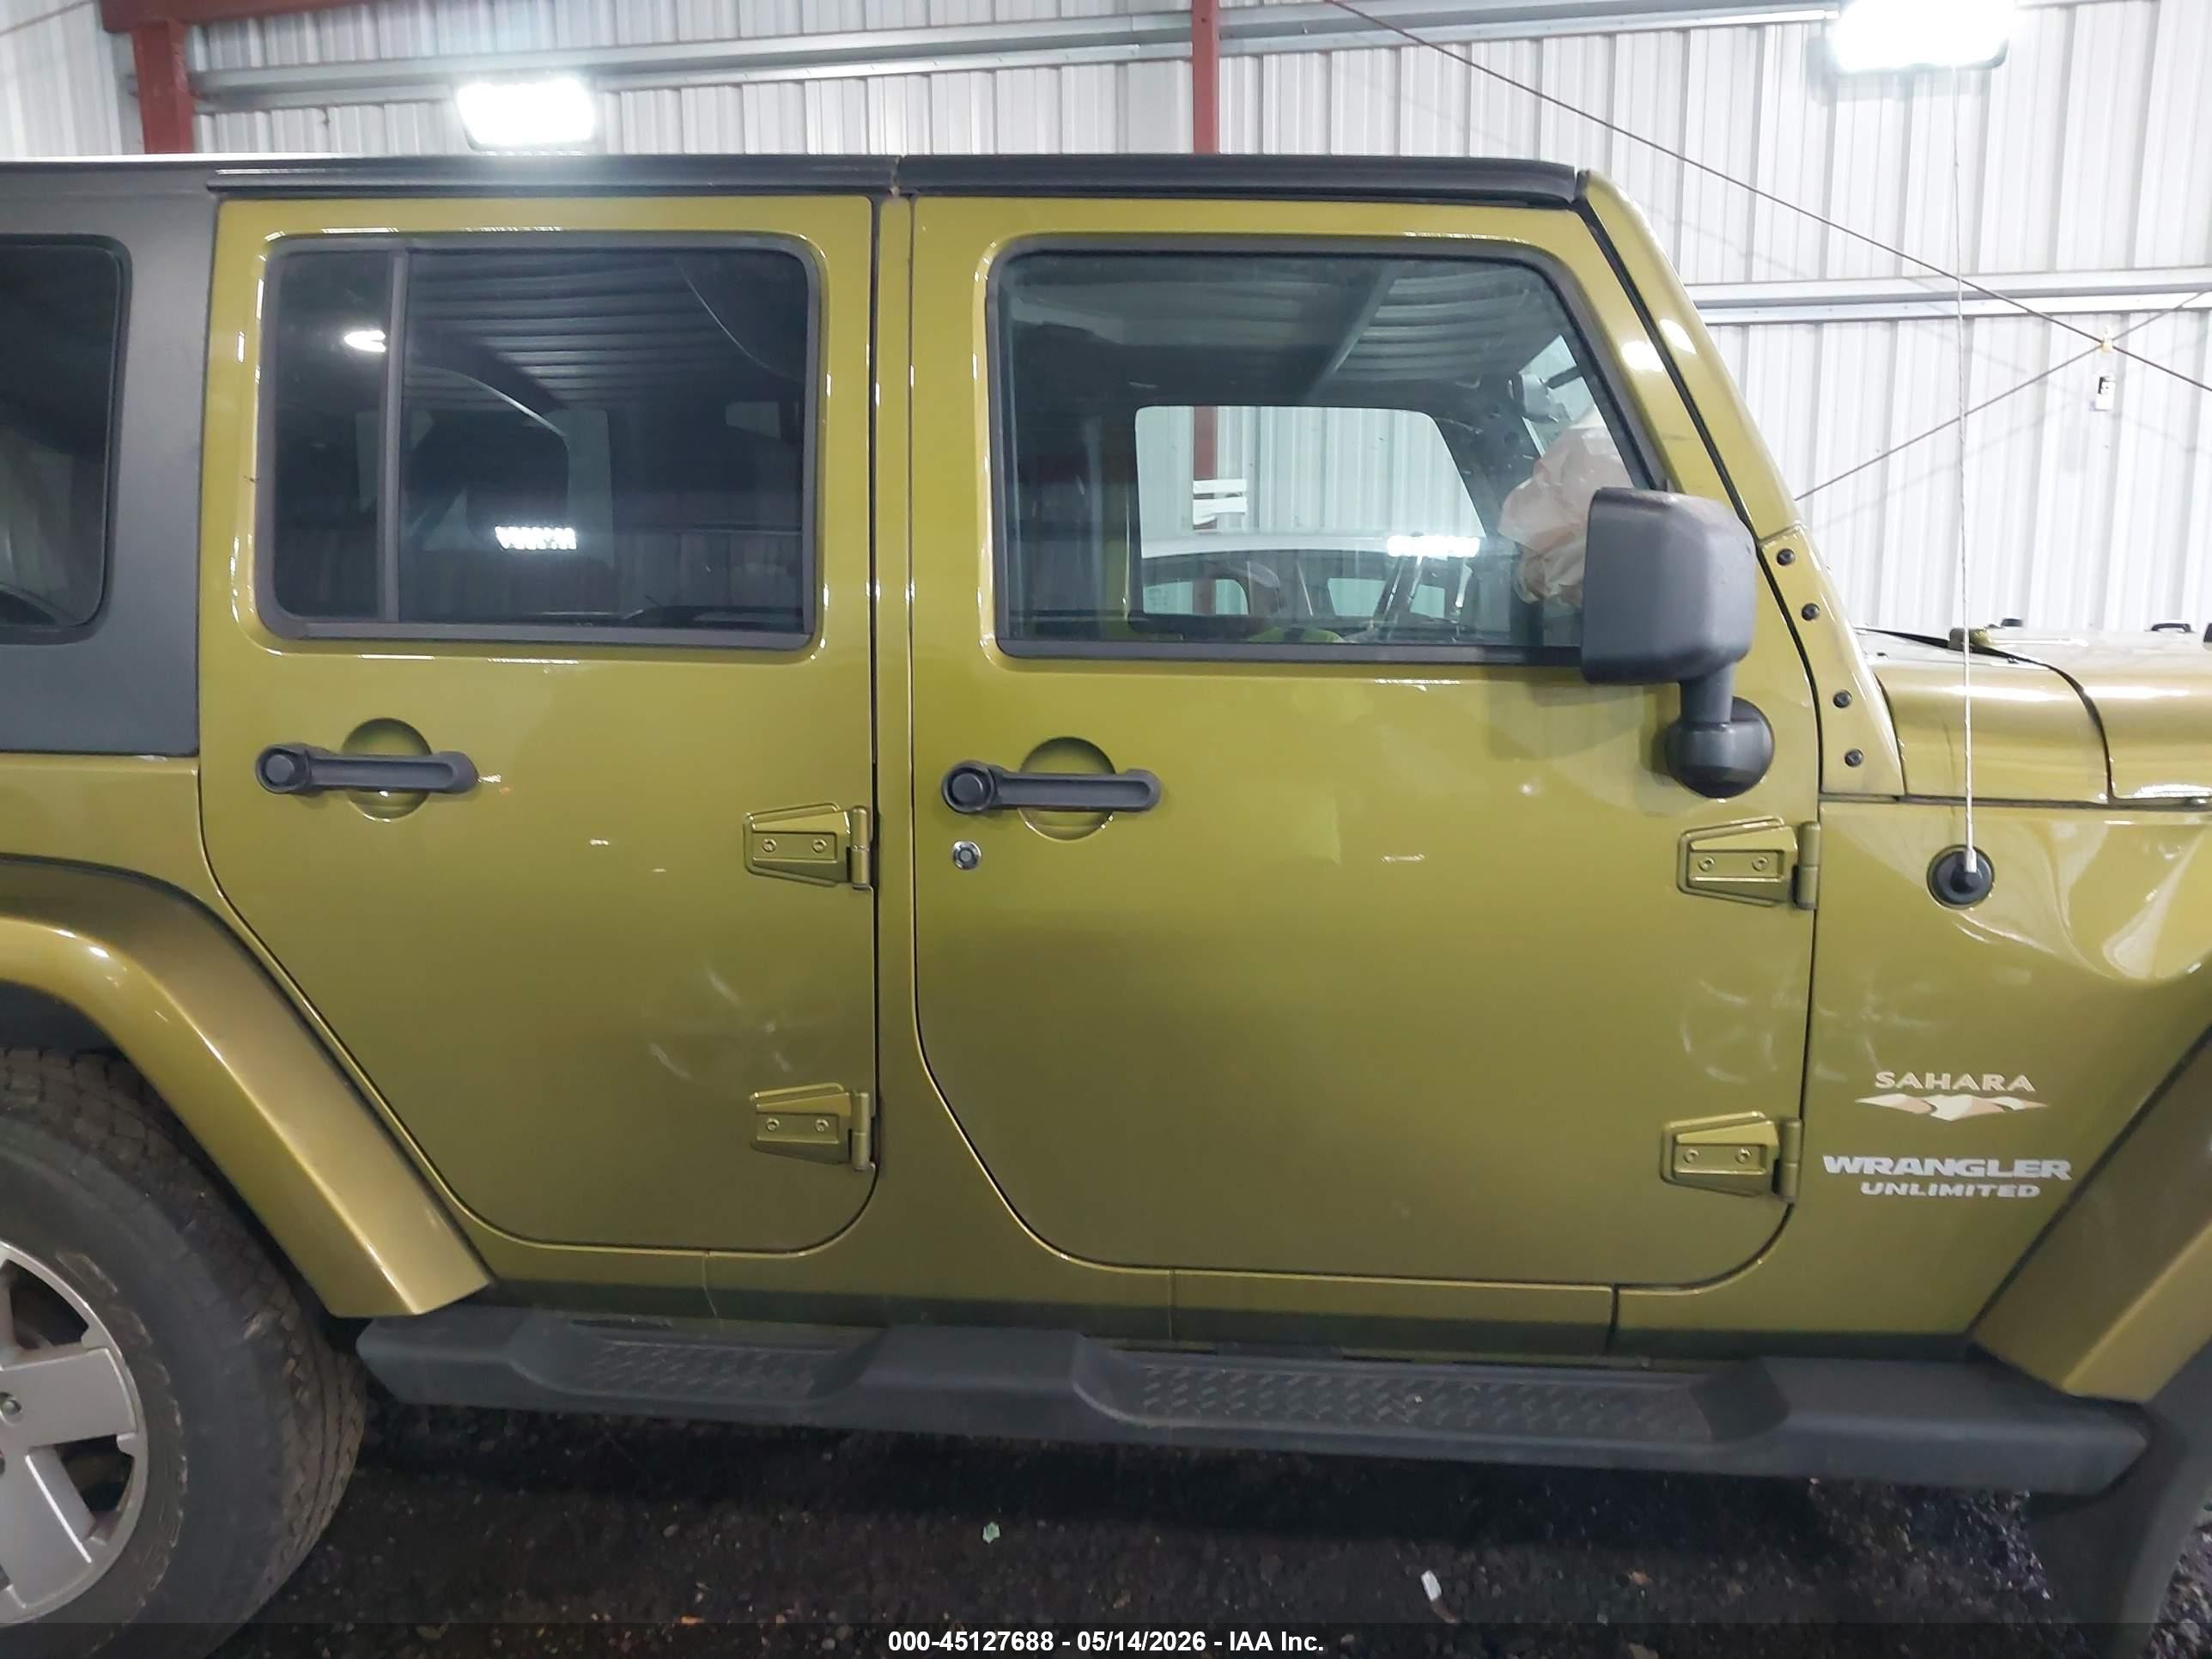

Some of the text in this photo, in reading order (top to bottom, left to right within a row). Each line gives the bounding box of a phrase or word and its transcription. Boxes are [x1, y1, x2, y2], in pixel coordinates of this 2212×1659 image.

[1875, 1072, 2036, 1092] SAHARA
[1822, 1155, 2072, 1181] WRANGLER
[1860, 1182, 2040, 1198] UNLIMITED
